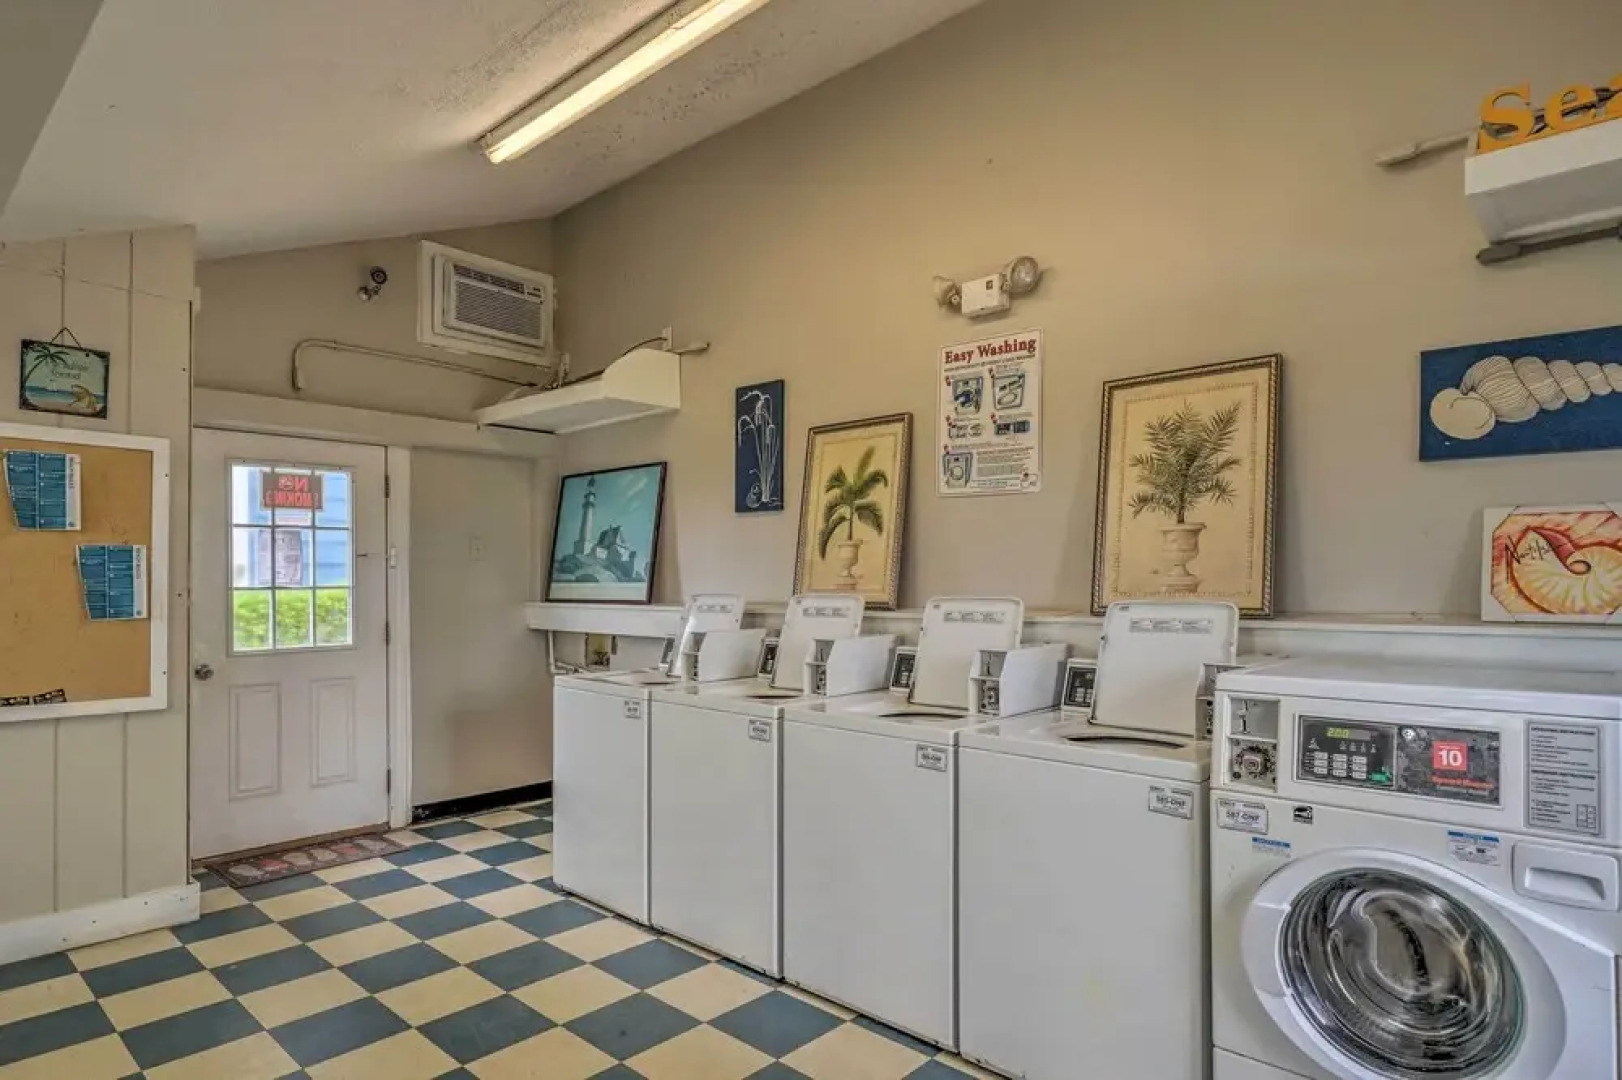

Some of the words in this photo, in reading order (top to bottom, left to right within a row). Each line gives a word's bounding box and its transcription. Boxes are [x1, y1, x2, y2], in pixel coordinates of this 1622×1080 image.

[944, 350, 974, 364] Easy
[977, 338, 1037, 357] Washing
[1438, 749, 1463, 766] 10
